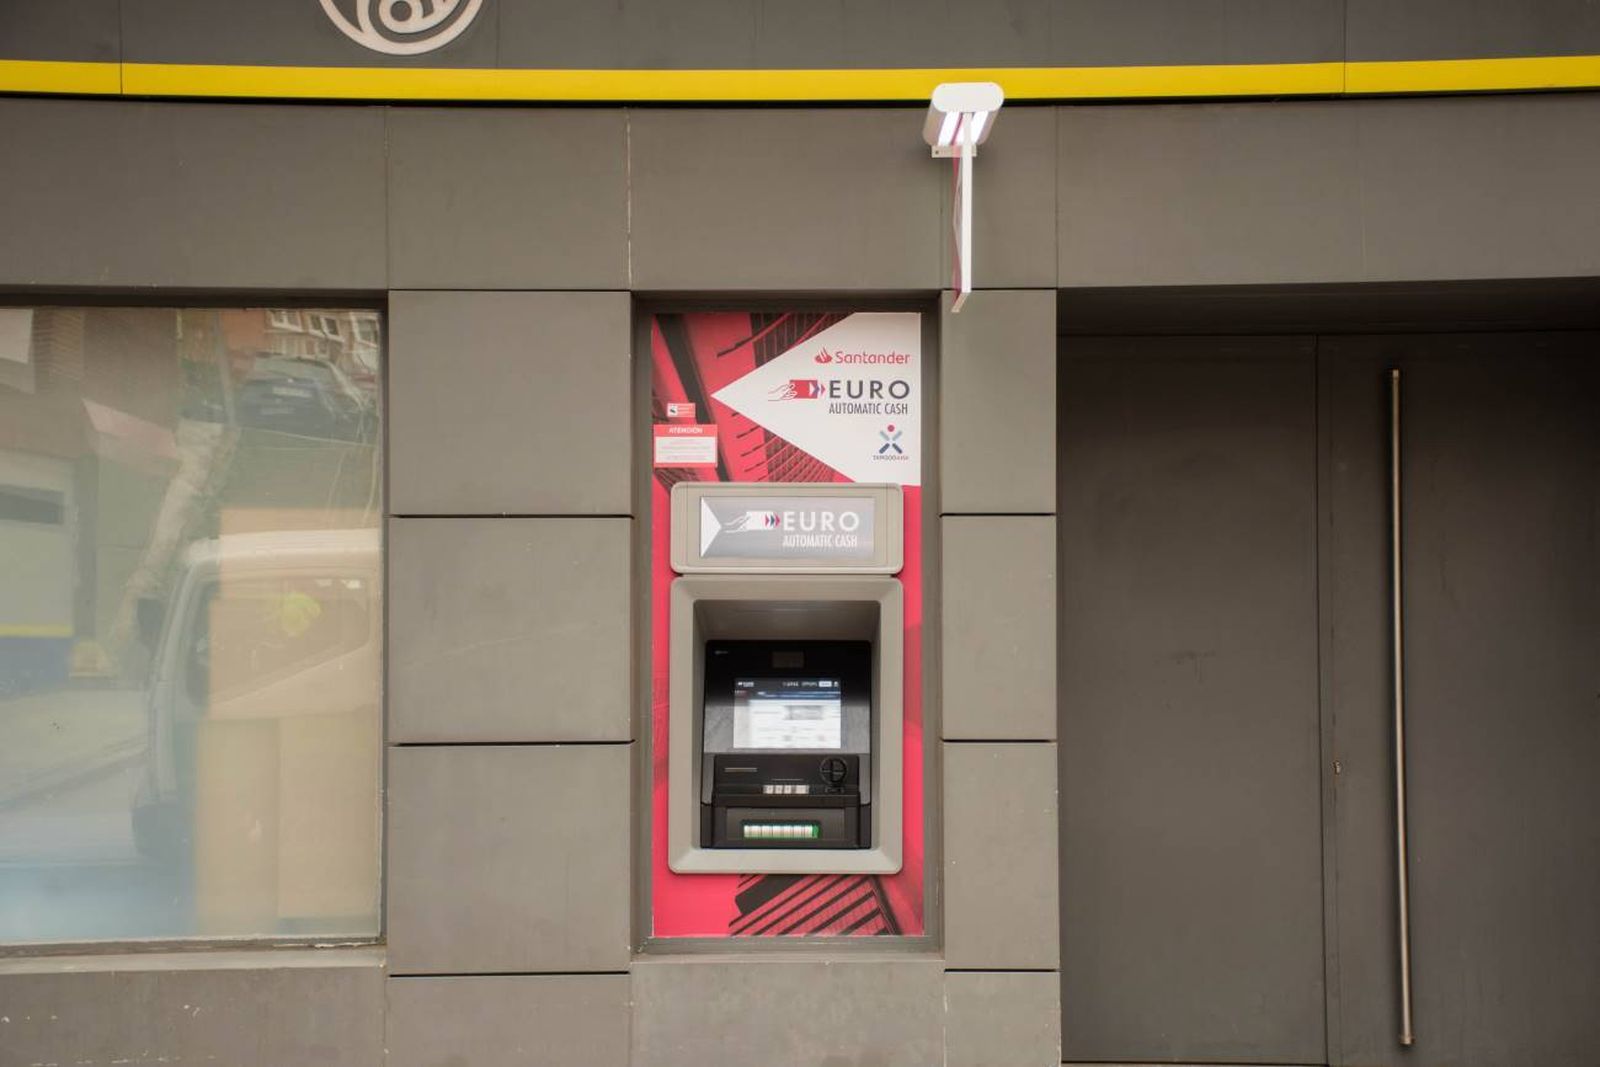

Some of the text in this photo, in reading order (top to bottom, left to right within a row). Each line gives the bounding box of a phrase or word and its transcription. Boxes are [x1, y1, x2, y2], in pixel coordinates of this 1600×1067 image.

[835, 351, 911, 364] Santander
[829, 380, 910, 399] EURO
[829, 403, 908, 414] AUTOMATIC CASH
[782, 511, 860, 531] EURO
[782, 535, 858, 548] AUTOMATIC CASH
